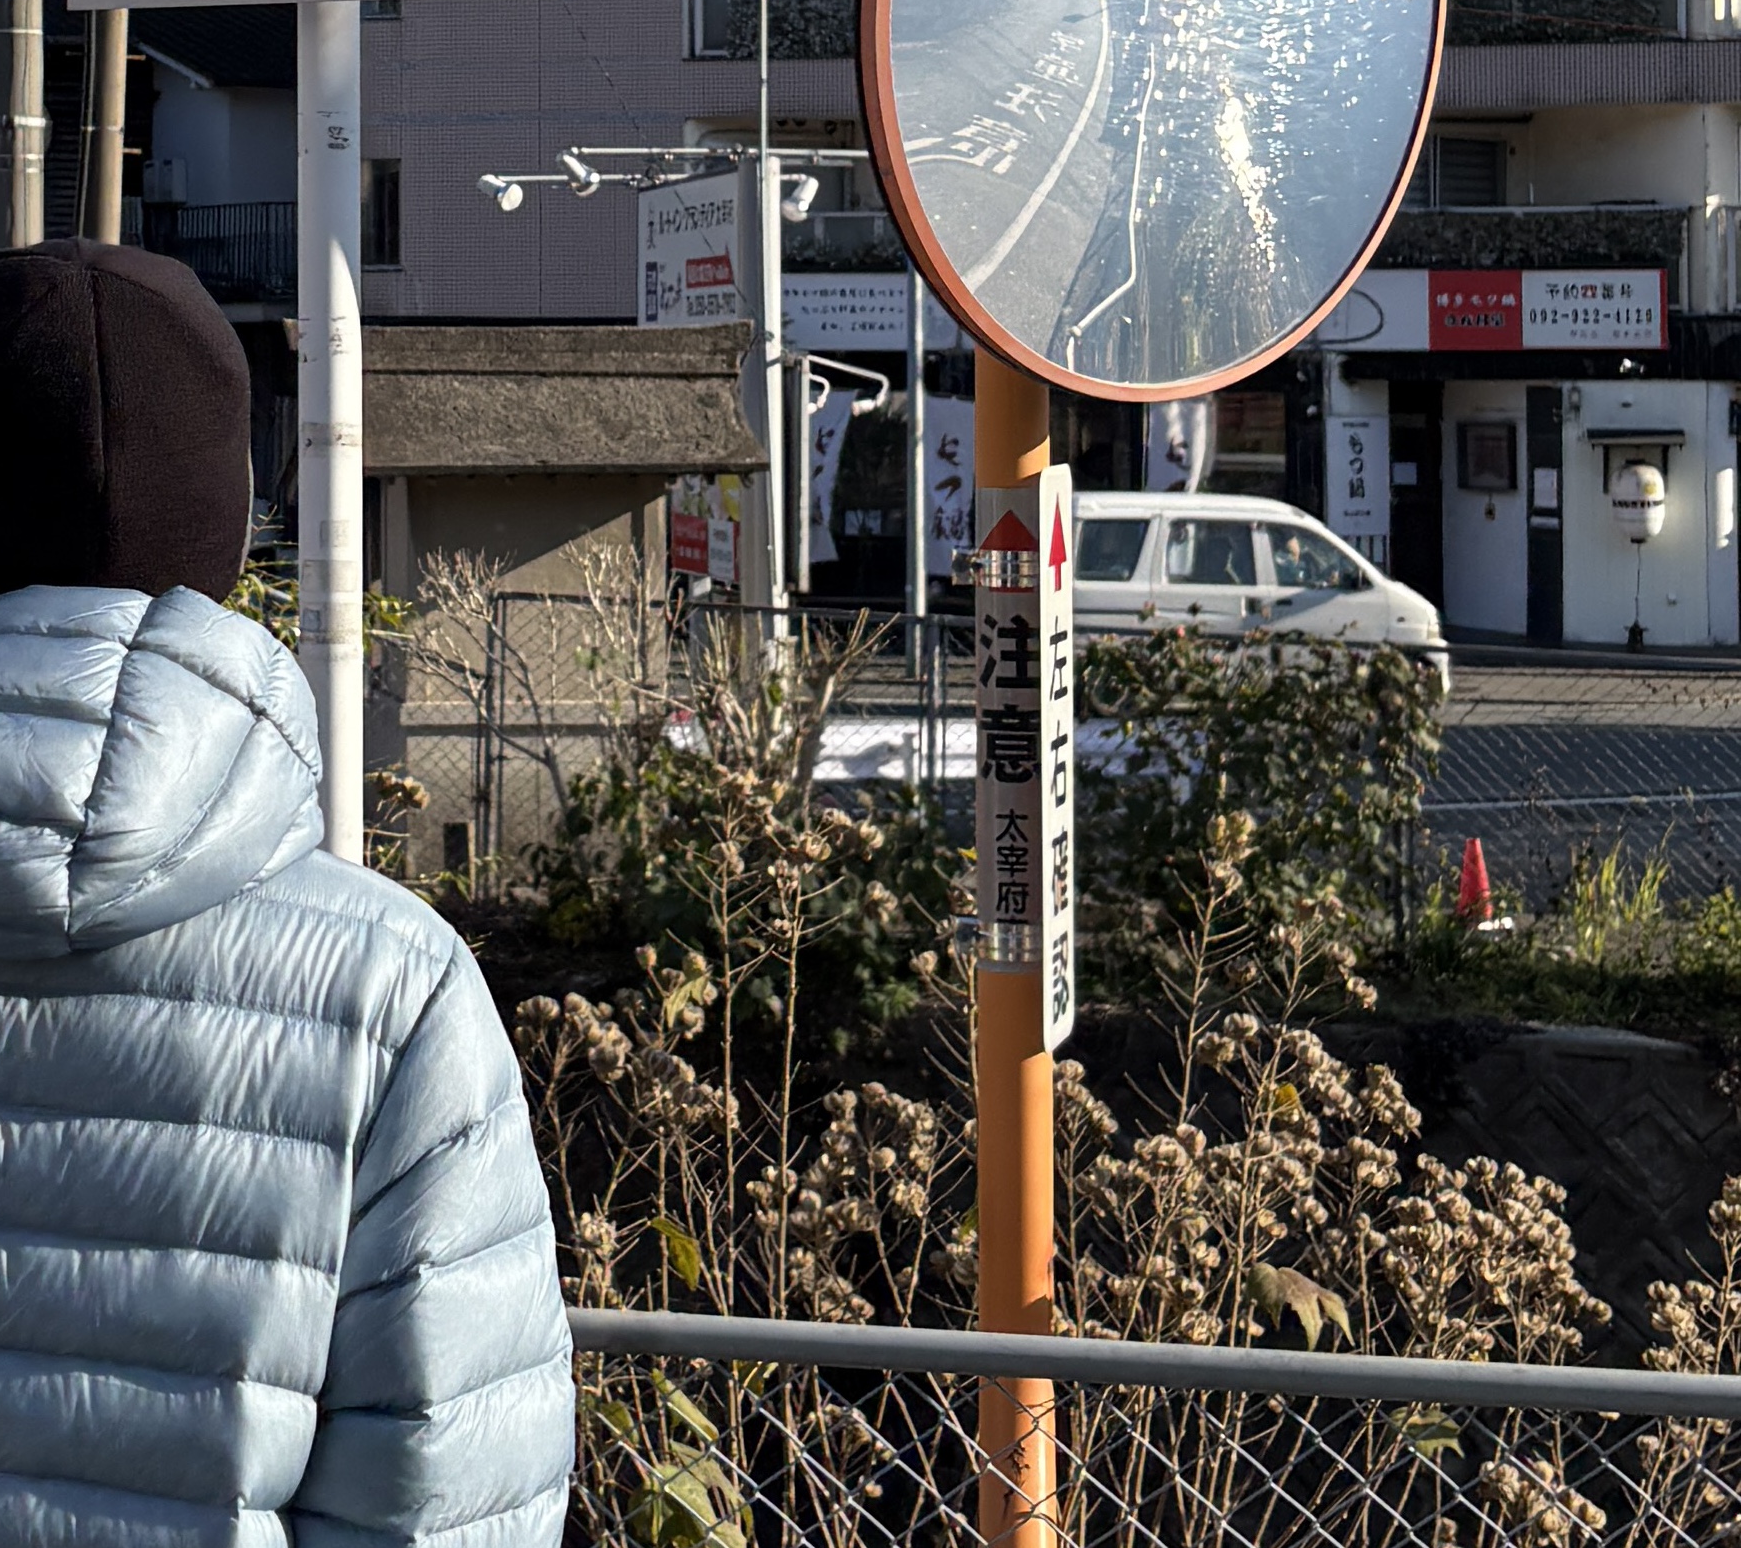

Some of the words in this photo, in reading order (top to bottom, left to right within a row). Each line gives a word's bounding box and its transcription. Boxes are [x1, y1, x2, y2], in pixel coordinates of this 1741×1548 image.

[979, 614, 1040, 784] 注意
[995, 808, 1029, 925] 太宰府
